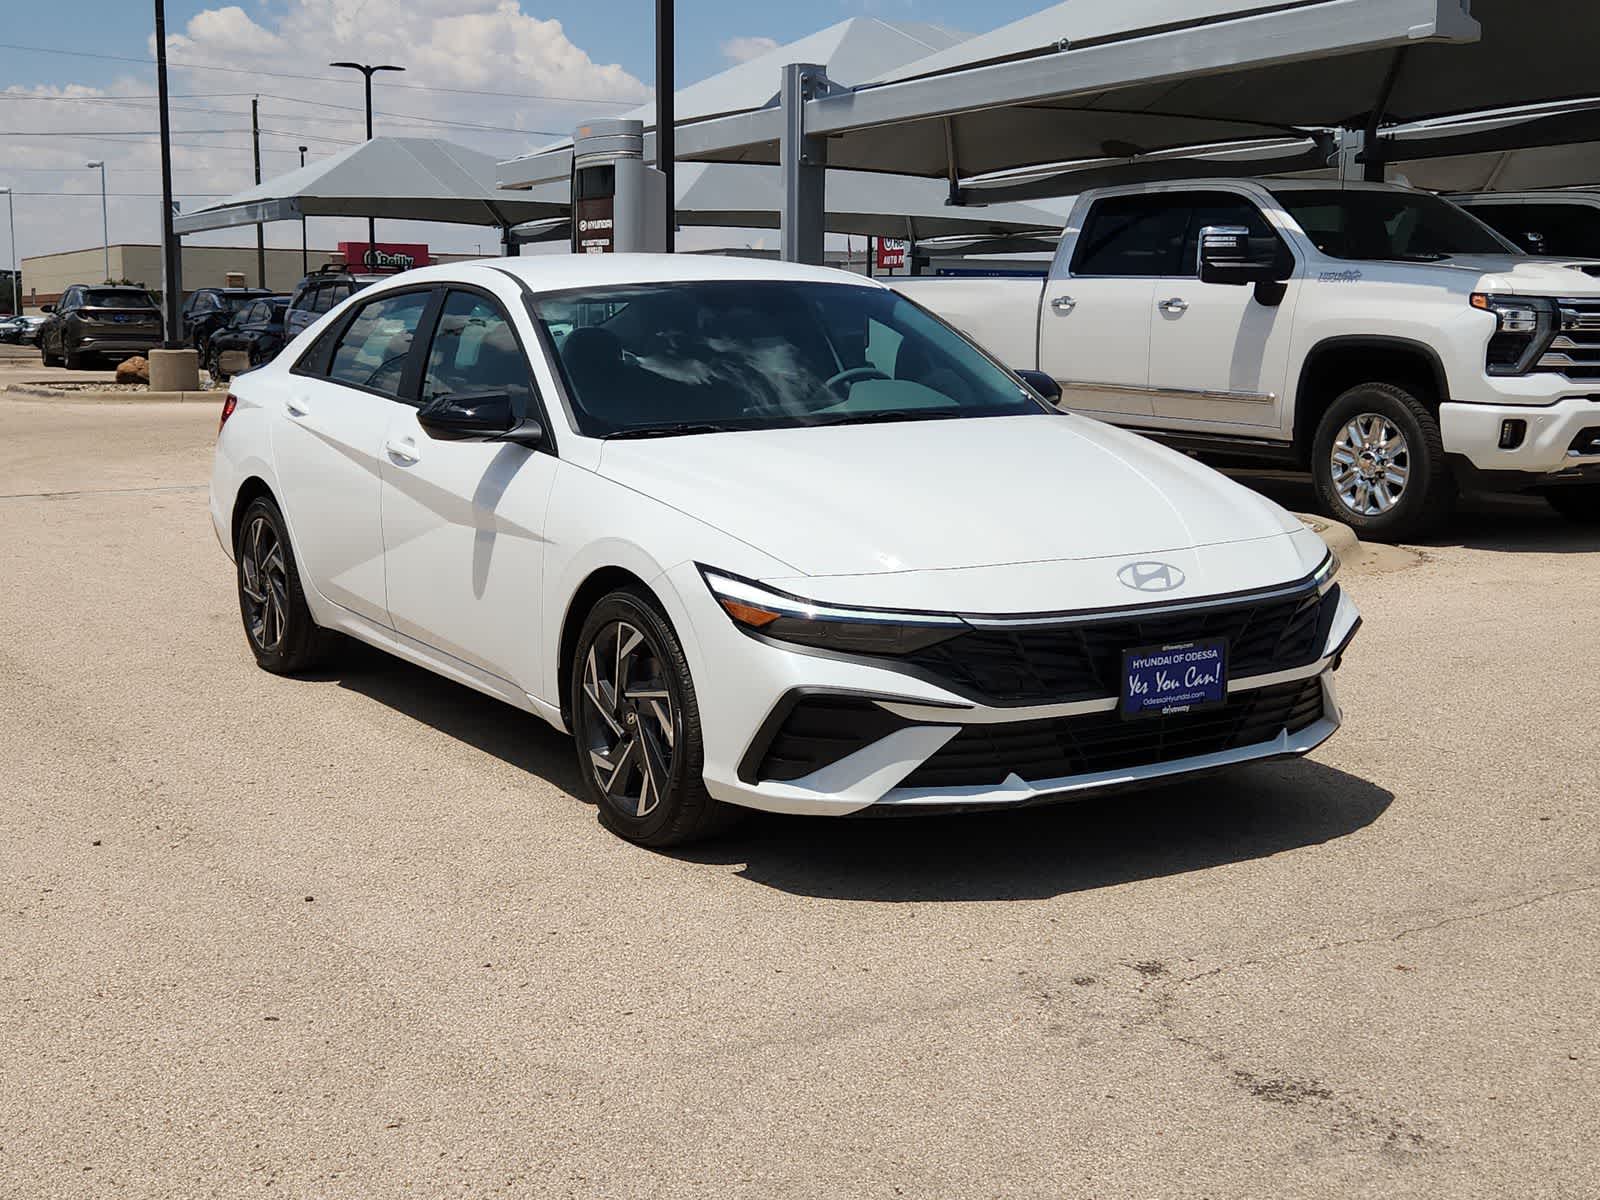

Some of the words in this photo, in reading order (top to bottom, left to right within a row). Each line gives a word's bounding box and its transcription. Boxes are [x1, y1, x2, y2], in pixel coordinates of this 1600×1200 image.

[1132, 656, 1172, 670] HYUNDAI
[1173, 653, 1184, 664] OF
[1185, 649, 1218, 662] ODESSA
[1129, 673, 1149, 697] Yes
[1156, 670, 1180, 693] You
[1184, 662, 1221, 688] Can!
[1142, 691, 1206, 706] OdessaHyundai.com
